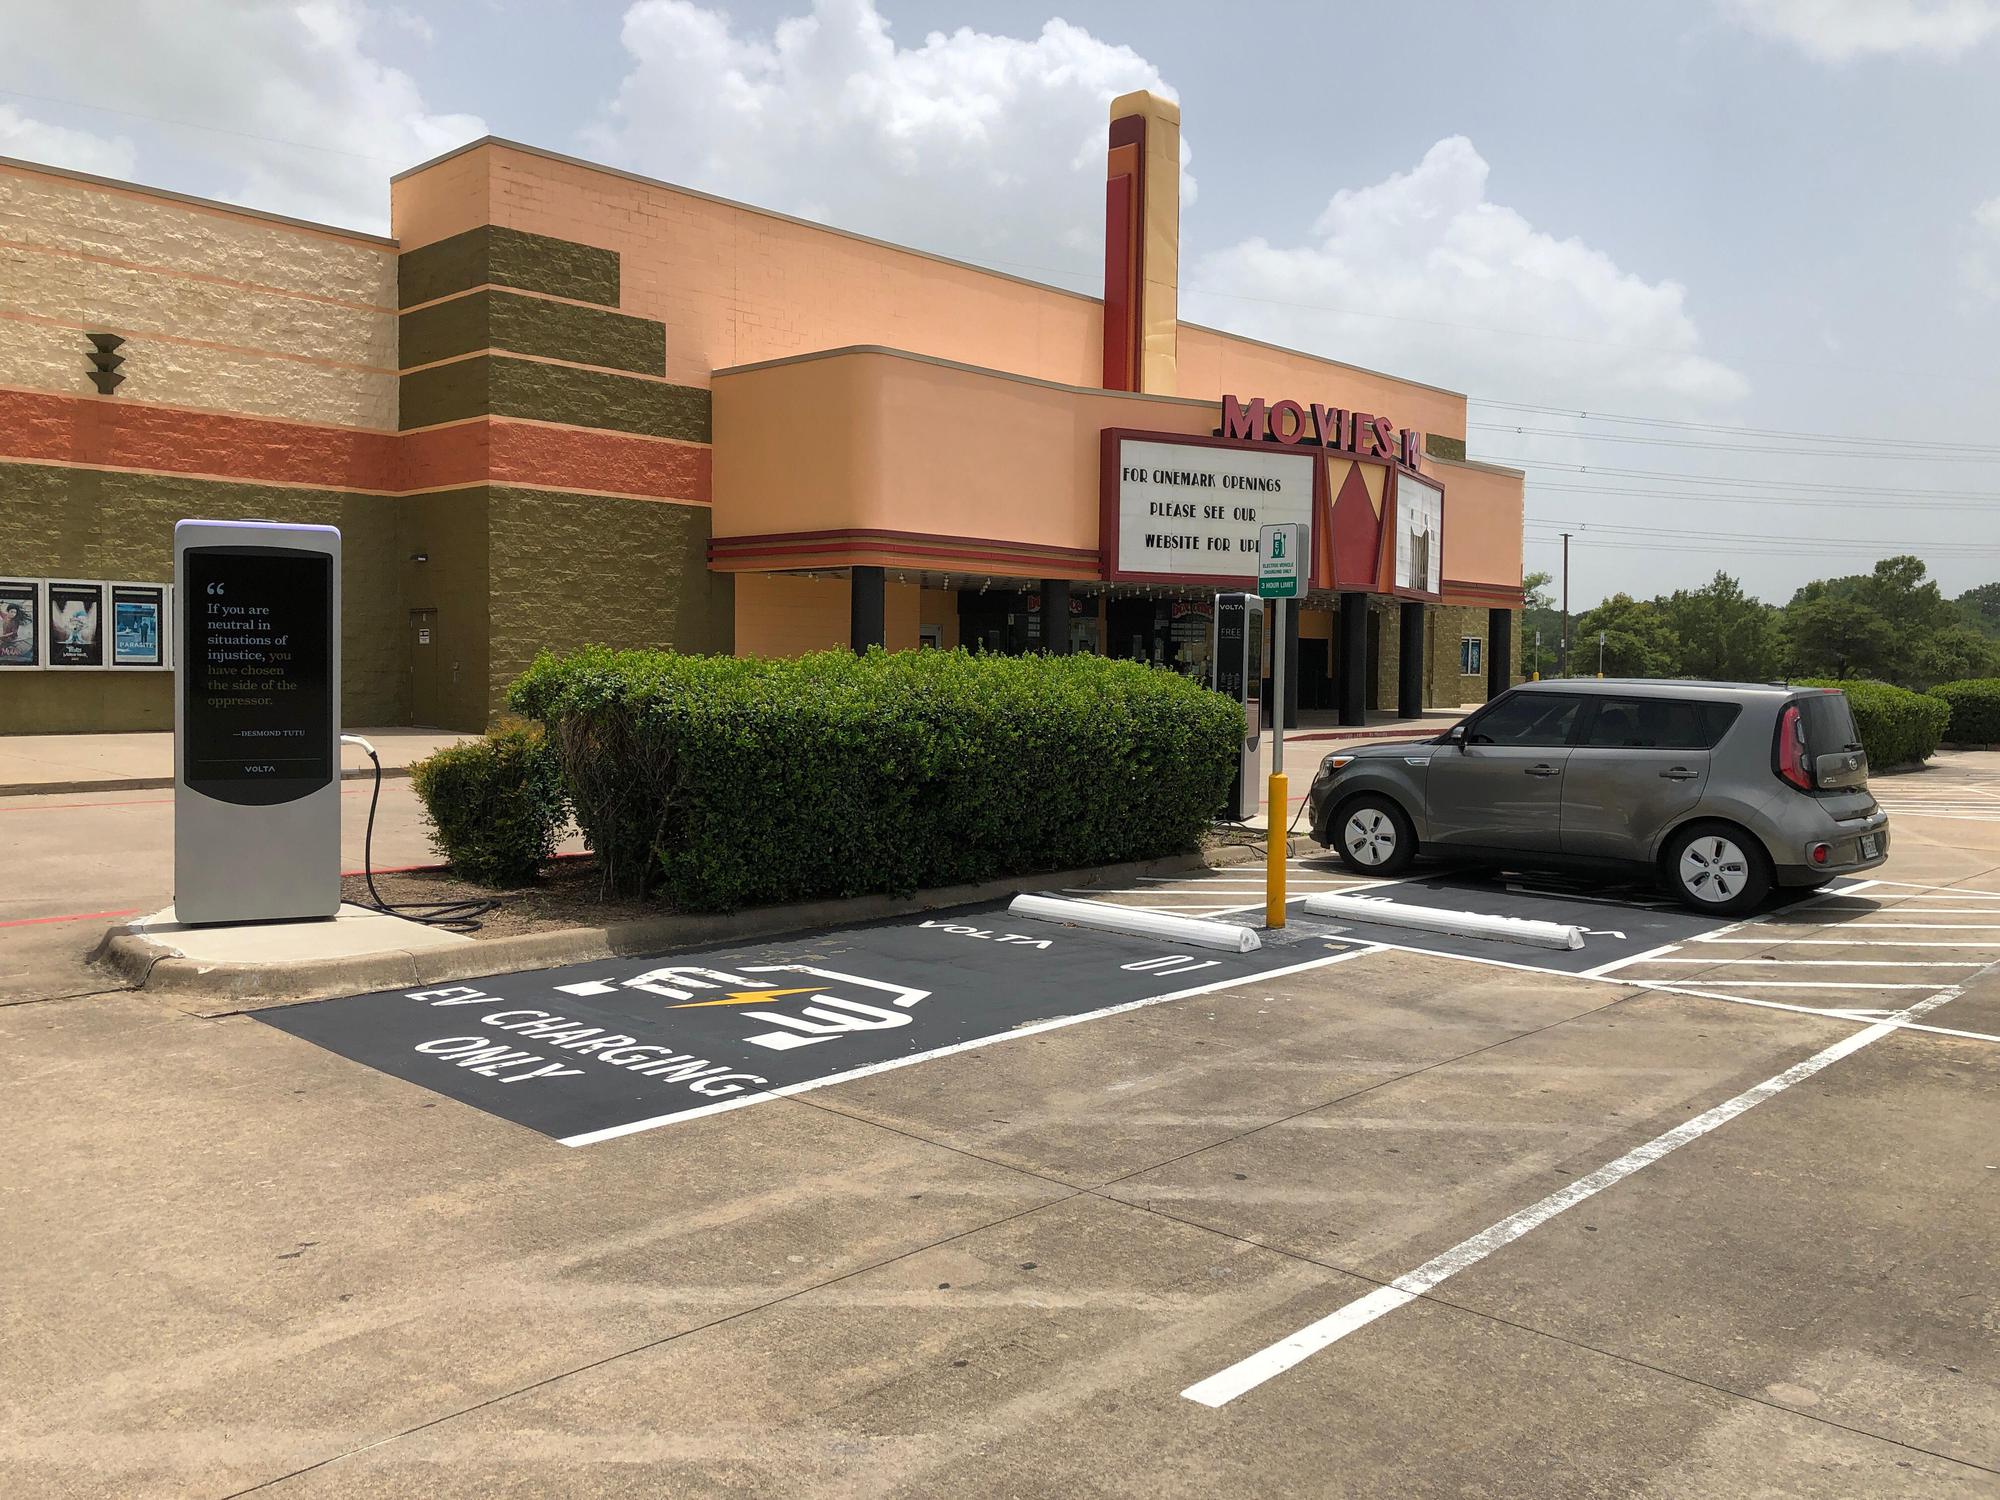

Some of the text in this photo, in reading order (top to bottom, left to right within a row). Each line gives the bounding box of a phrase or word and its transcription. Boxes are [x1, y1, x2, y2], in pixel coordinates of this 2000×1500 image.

[1222, 395, 1394, 460] MOVIES
[1123, 468, 1281, 492] FOR CINEMARK OPENINGS
[1150, 502, 1256, 522] PLEASE SEE OUR
[1145, 534, 1200, 550] WEBSITE
[1207, 538, 1230, 551] FOR
[207, 603, 270, 617] If you are
[207, 620, 271, 630] neutral in
[207, 633, 289, 645] situations of
[207, 649, 292, 663] injustice, you
[207, 665, 284, 675] have chosen
[208, 680, 297, 690] the side of the
[207, 697, 273, 708] oppressor.
[245, 765, 276, 773] VOLTA
[917, 920, 1053, 950] VOLTA
[404, 986, 769, 1096] EV CHARGING
[414, 1036, 586, 1084] ONLY
